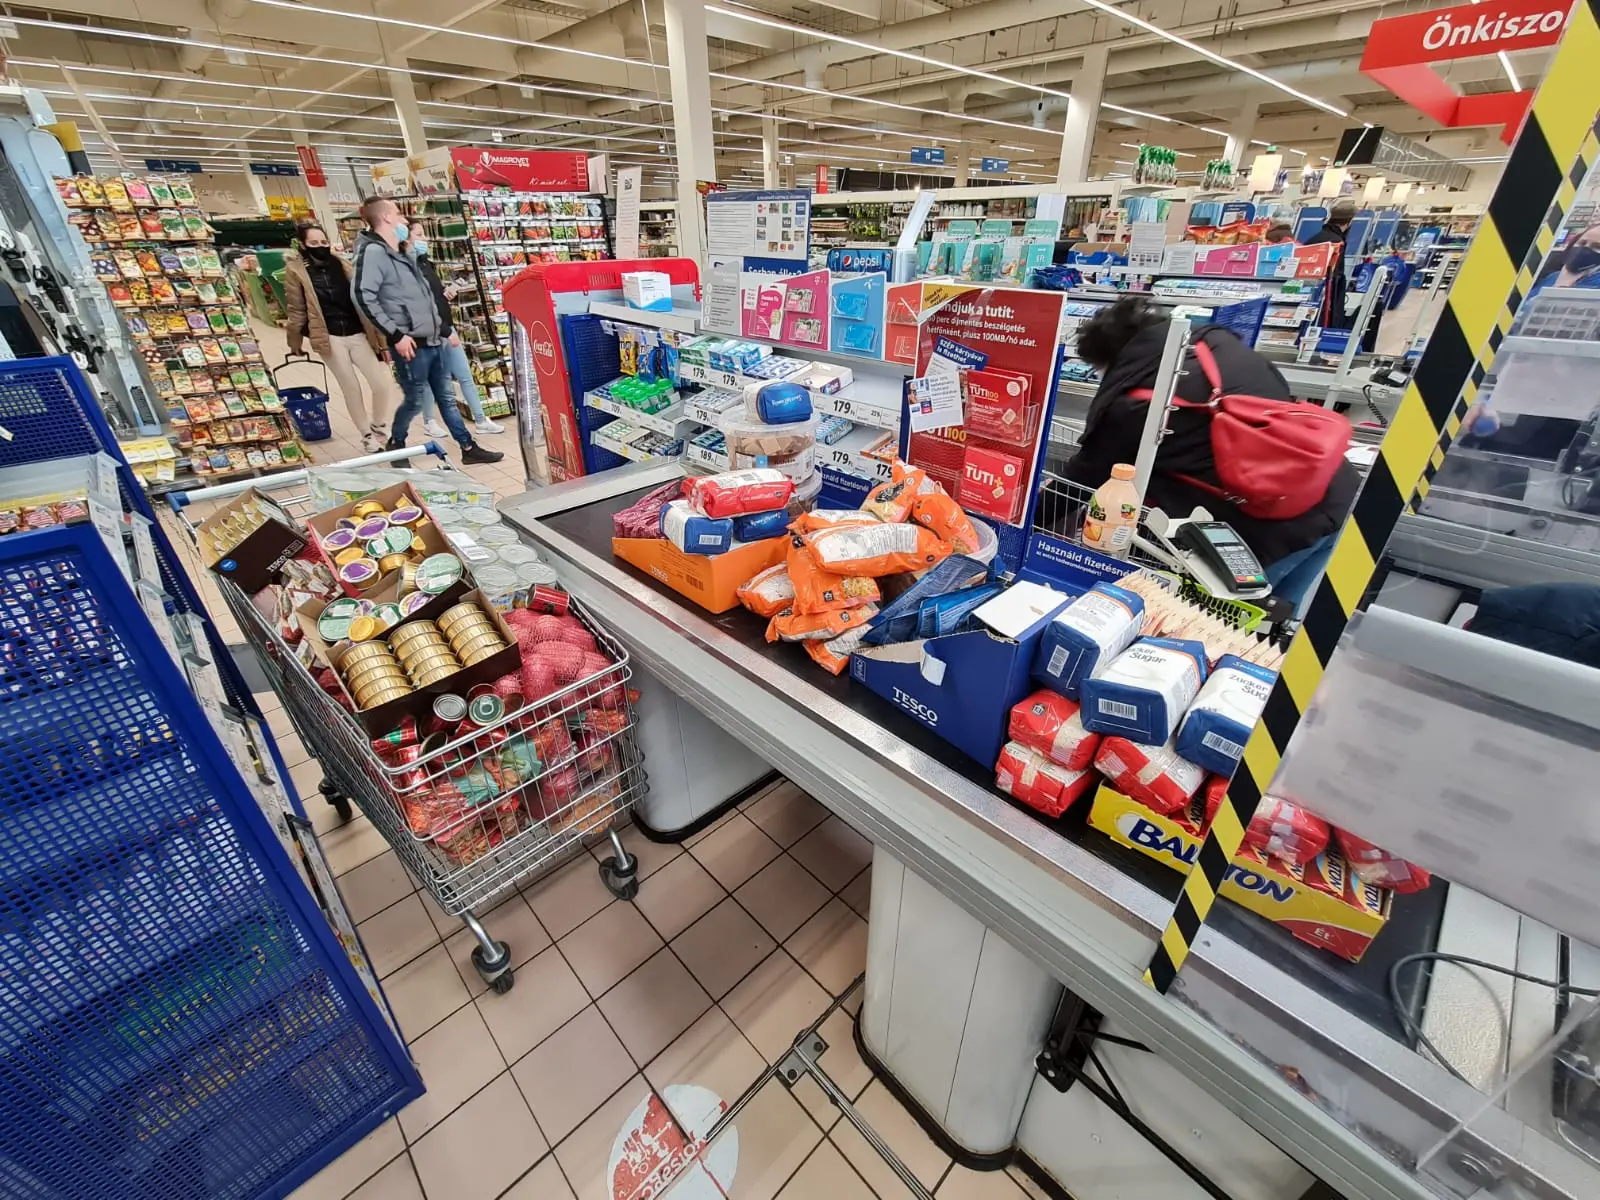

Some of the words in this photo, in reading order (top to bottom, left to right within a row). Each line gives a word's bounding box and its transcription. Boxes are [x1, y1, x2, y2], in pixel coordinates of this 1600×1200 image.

[1422, 10, 1564, 50] Önkiszo
[853, 255, 879, 268] pepsi
[975, 305, 983, 316] a
[985, 304, 1015, 319] tutit:
[984, 320, 1026, 332] beszélgetés
[940, 339, 955, 350] SZÉP
[962, 330, 981, 339] plusz
[983, 332, 1018, 344] 100MB/hó
[1019, 337, 1037, 347] adat.
[693, 367, 705, 379] 179
[723, 374, 736, 386] 179
[833, 400, 851, 414] 179
[696, 410, 708, 421] 179
[700, 449, 712, 461] 189
[832, 450, 849, 465] 179
[1038, 540, 1083, 562] Használd
[1084, 556, 1133, 577] fizetésné
[1129, 652, 1167, 664] Sugar
[1229, 674, 1269, 692] Zucker
[1241, 685, 1268, 700] Sug
[892, 686, 938, 722] TESCO
